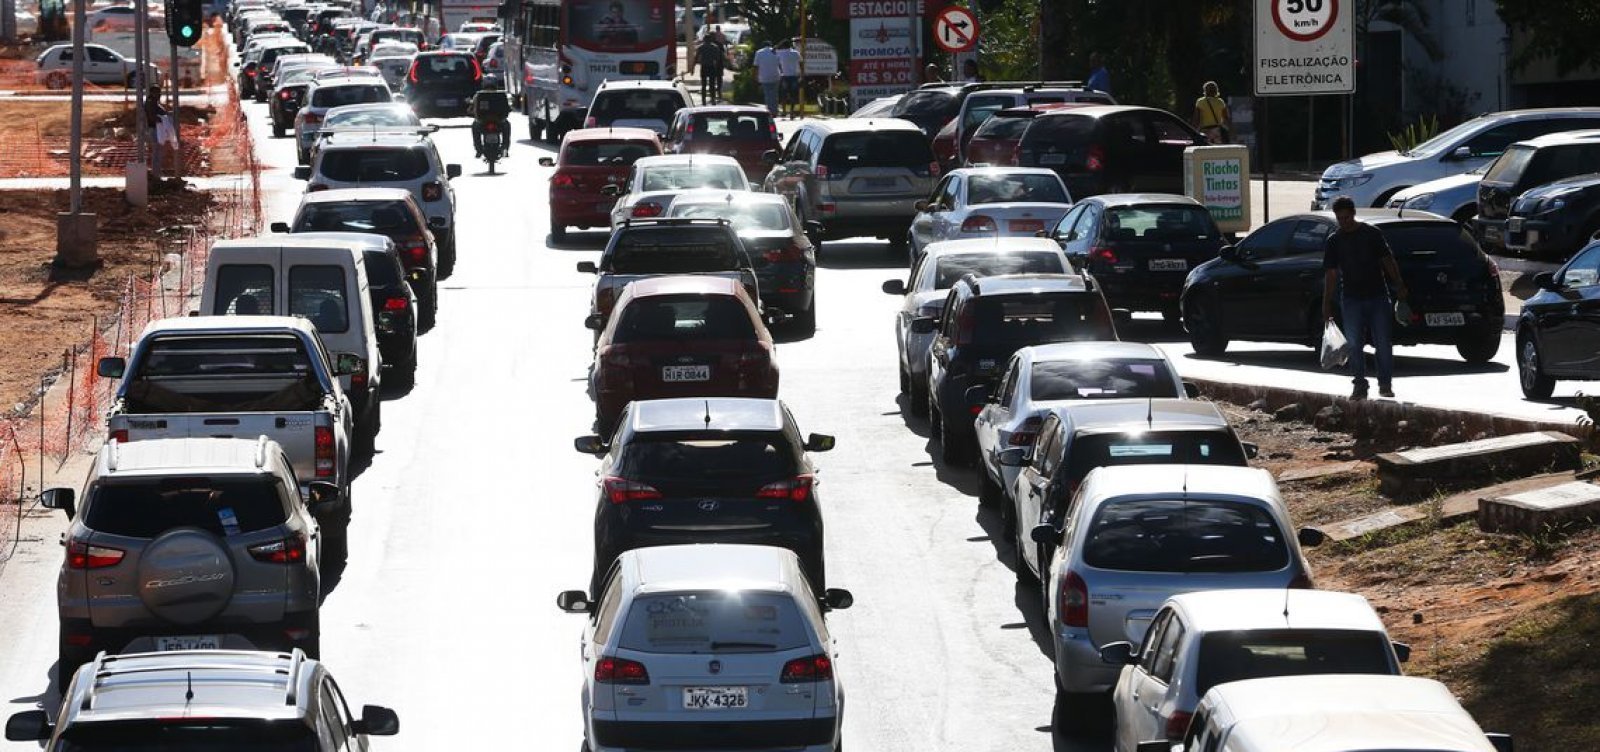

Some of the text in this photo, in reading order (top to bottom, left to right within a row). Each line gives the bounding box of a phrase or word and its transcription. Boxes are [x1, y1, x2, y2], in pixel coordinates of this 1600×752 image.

[1294, 18, 1319, 27] km/h
[1261, 55, 1348, 68] FISCALIZAÇÃO
[1265, 72, 1343, 85] ELETRÔNICA
[1203, 160, 1240, 174] Riacho
[1206, 177, 1239, 191] Tintas
